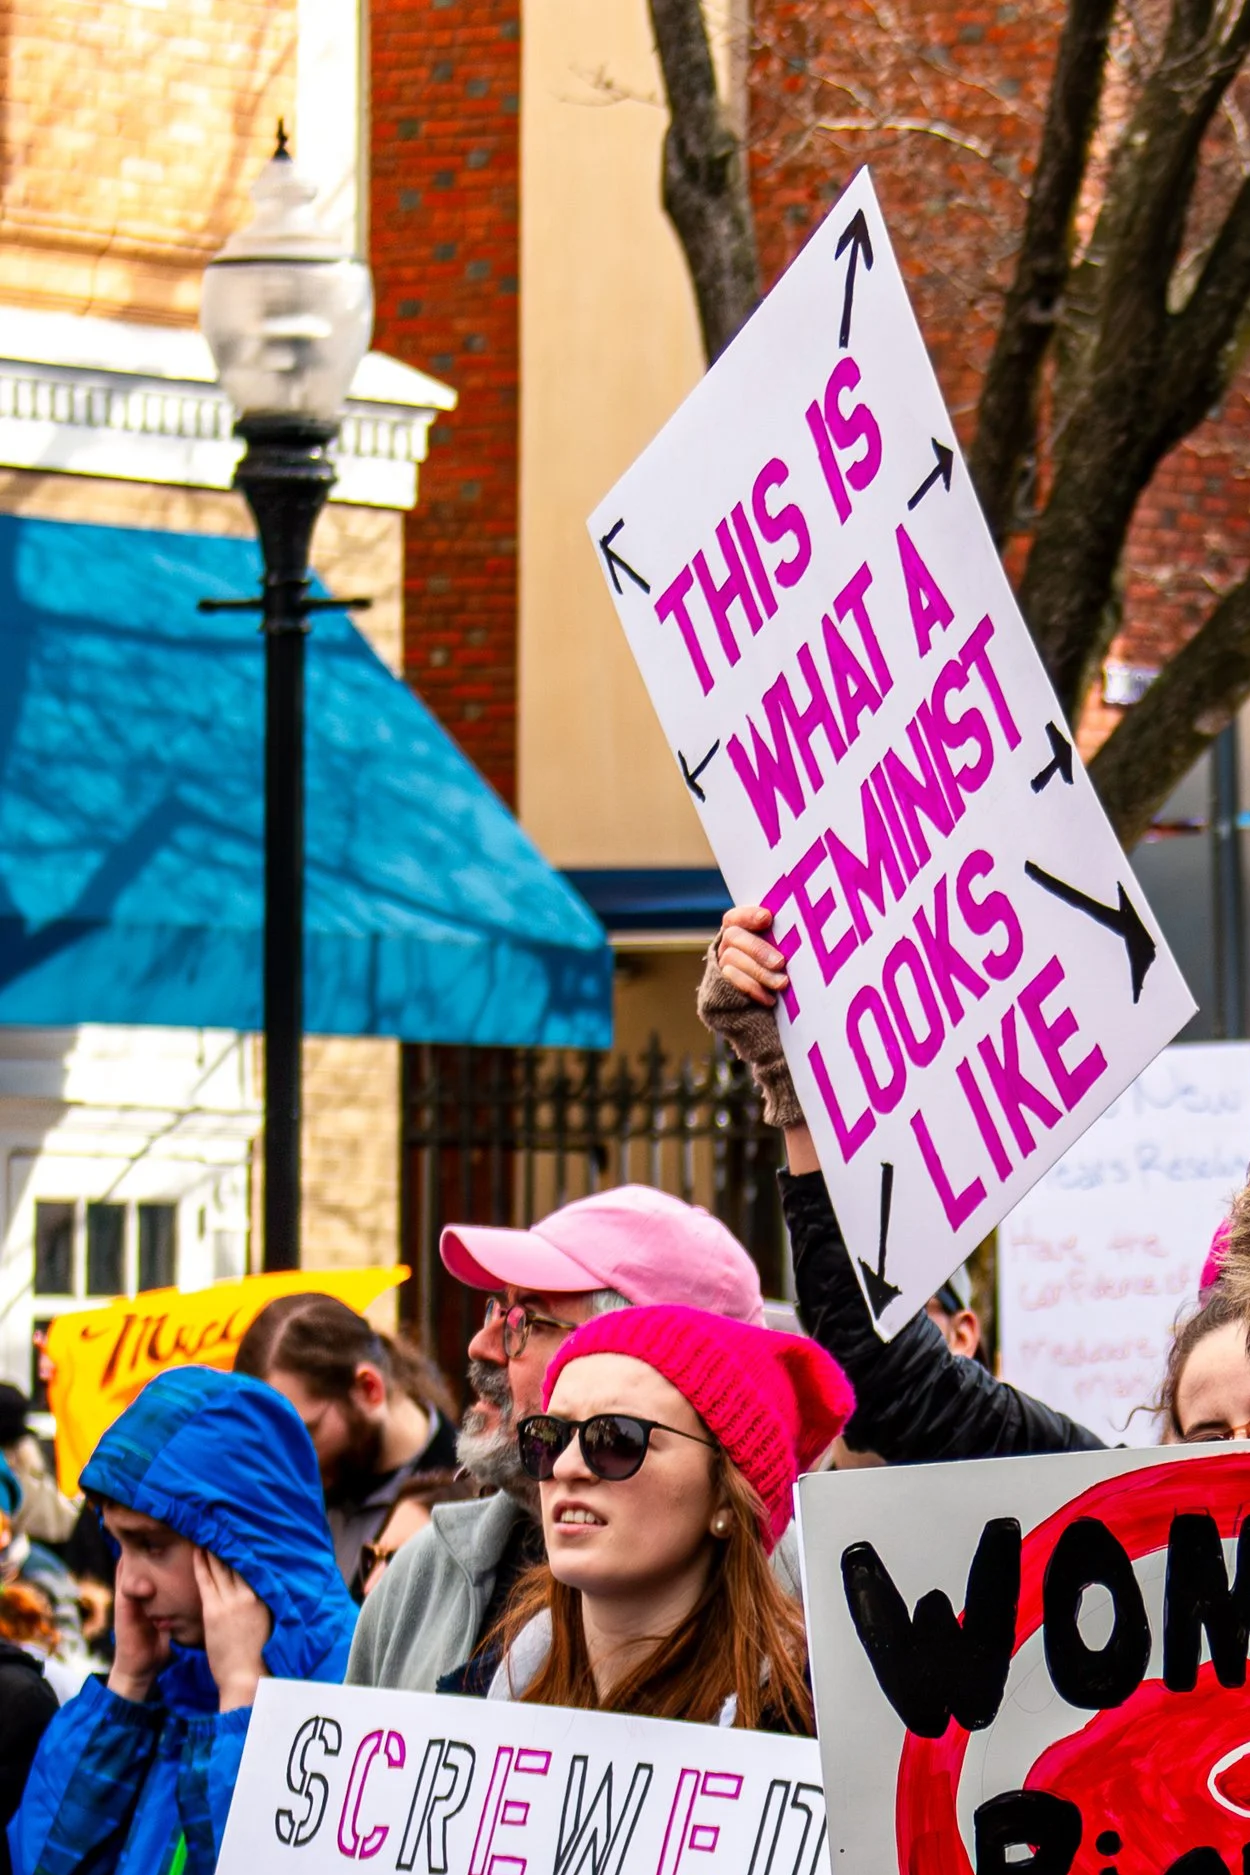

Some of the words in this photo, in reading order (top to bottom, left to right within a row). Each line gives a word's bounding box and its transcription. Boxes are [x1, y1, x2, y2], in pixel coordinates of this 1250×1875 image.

[655, 458, 812, 696] THIS
[806, 357, 883, 525] IS
[727, 562, 894, 848] WHAT
[896, 524, 955, 657] A
[759, 614, 1022, 1024] FEMINIST
[808, 849, 1024, 1163] LOOKS
[910, 955, 1108, 1232] LIKE
